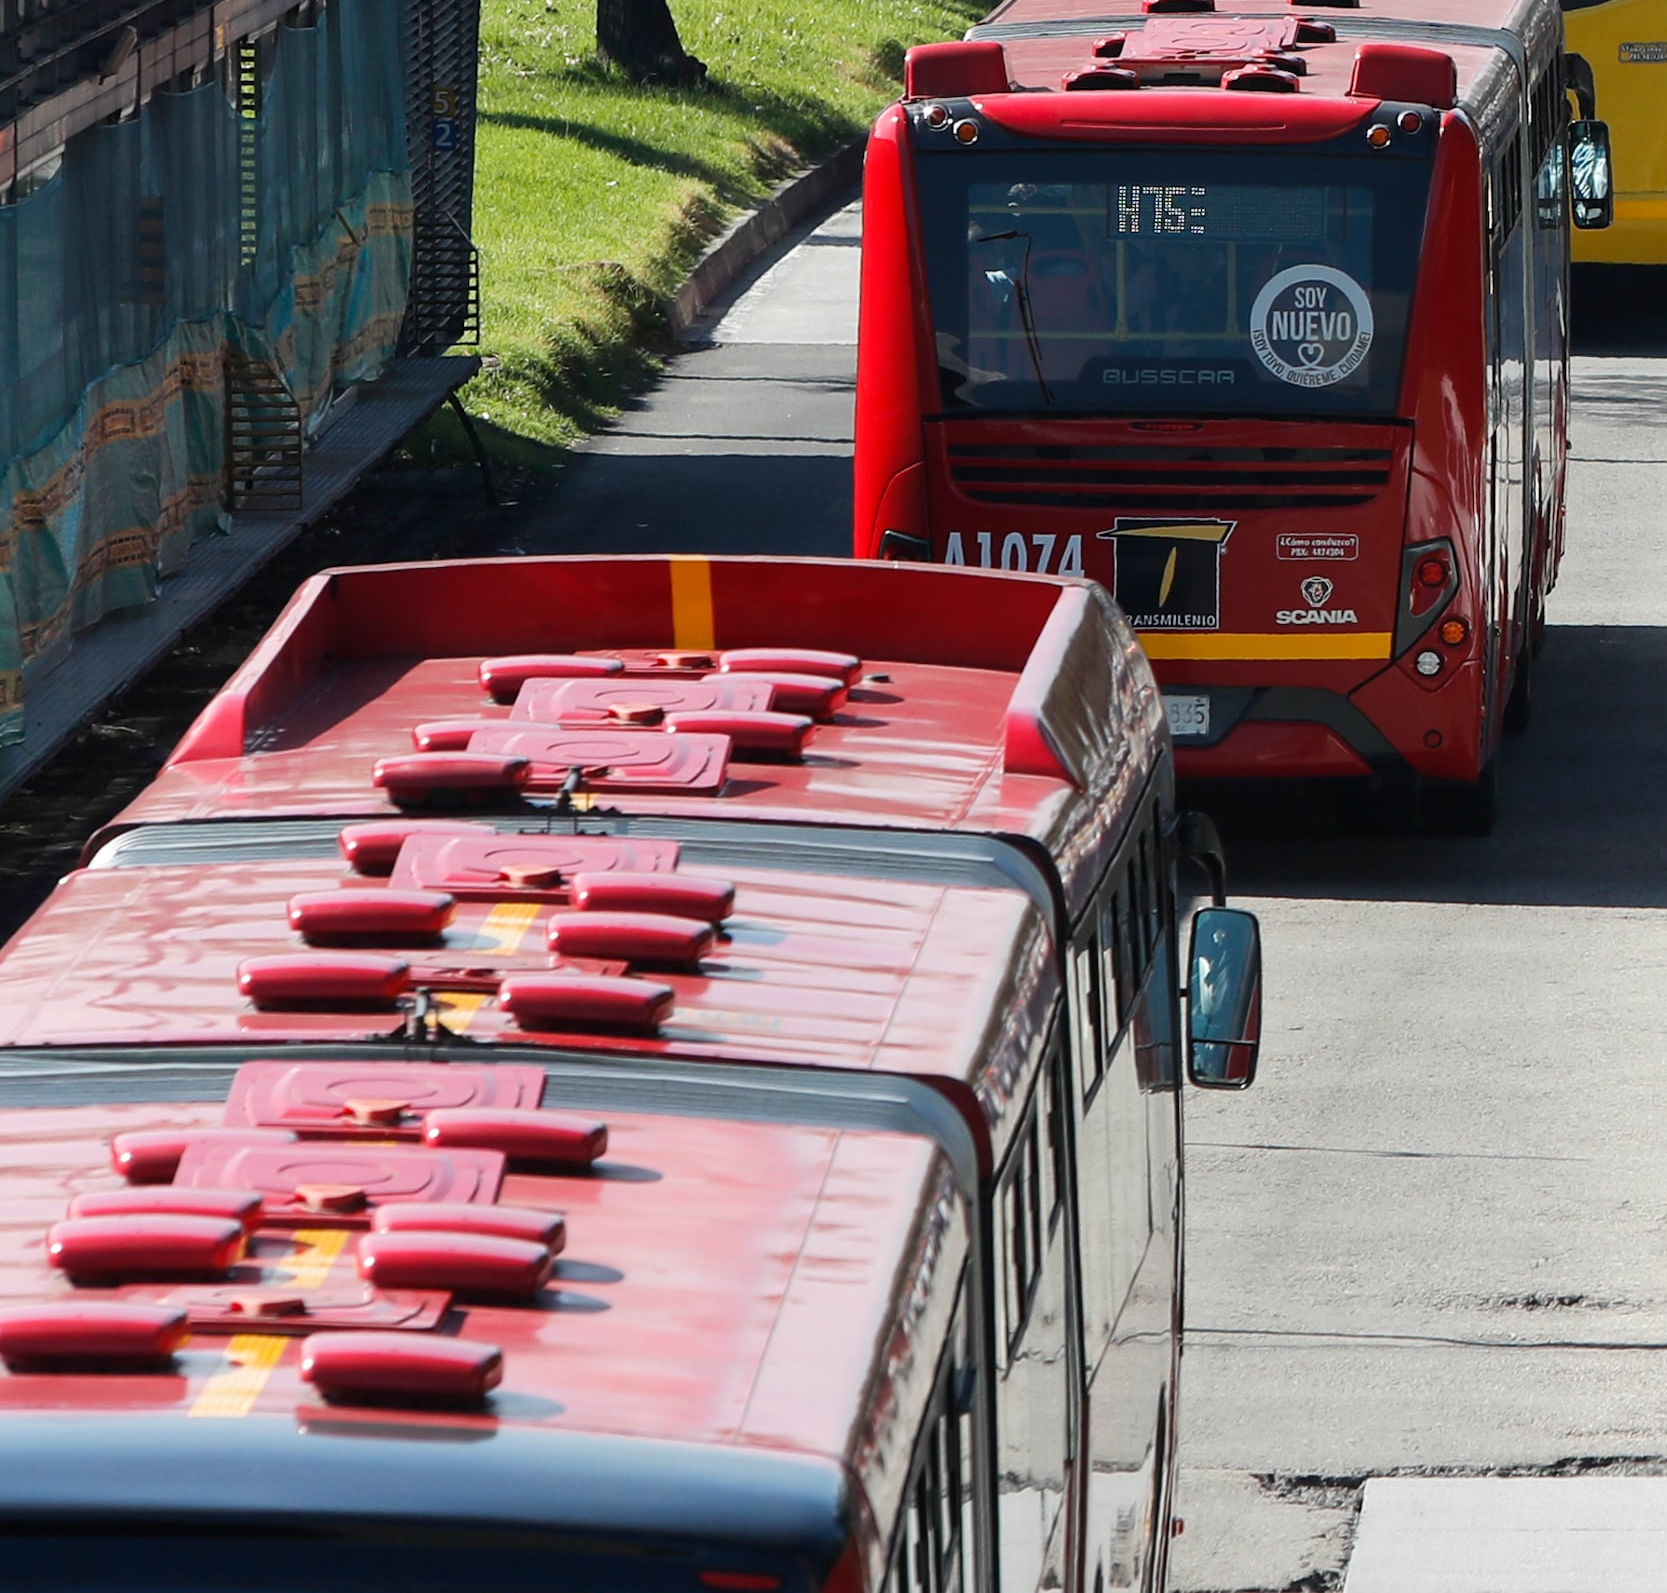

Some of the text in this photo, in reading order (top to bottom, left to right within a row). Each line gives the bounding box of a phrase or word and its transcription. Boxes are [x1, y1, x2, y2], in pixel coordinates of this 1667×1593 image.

[434, 91, 450, 112] 5
[436, 124, 452, 147] 2
[1294, 287, 1328, 308] SOY
[1271, 310, 1352, 341] NUEVO
[1102, 368, 1236, 384] BUSSCAR
[944, 532, 1085, 578] A1074
[1126, 614, 1217, 627] RANSMILENIO
[1275, 609, 1359, 624] SCANIA
